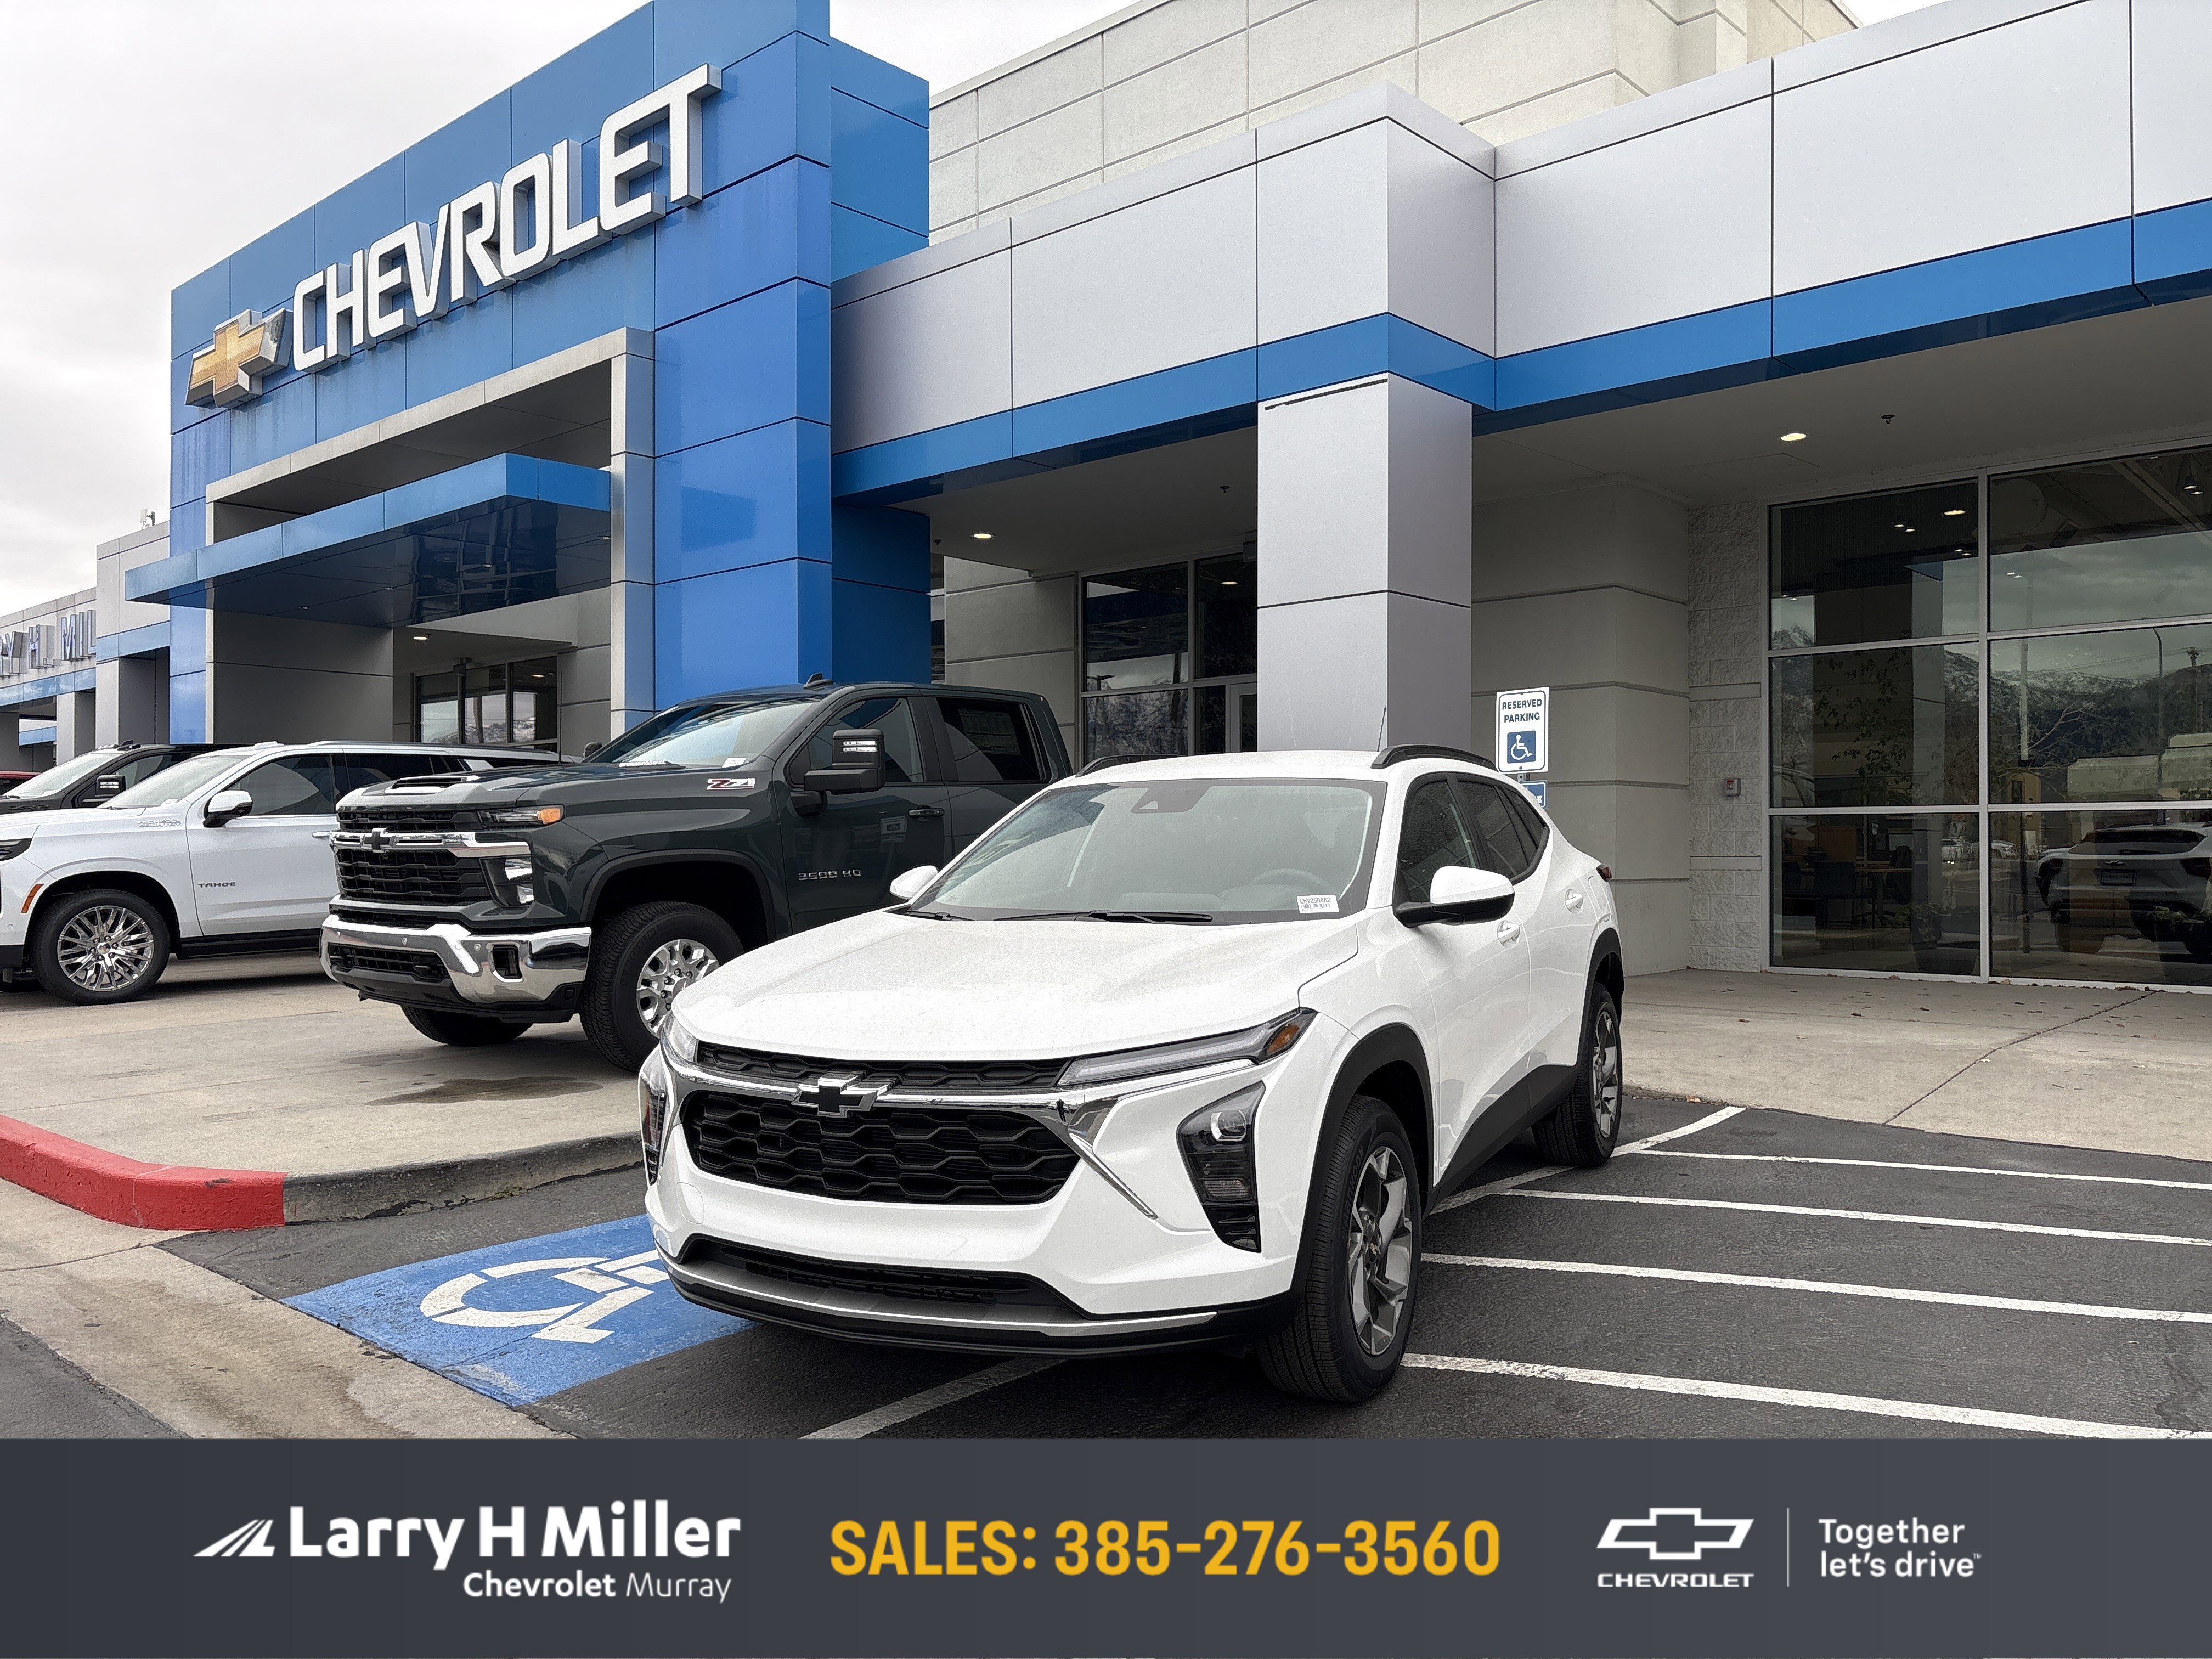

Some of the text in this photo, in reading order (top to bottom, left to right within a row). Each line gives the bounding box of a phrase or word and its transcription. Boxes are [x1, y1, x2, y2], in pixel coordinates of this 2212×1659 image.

[293, 63, 720, 373] CHEVROLET
[1502, 698, 1542, 710] RESERVED
[1504, 712, 1540, 723] PARKING
[798, 871, 838, 881] 3500
